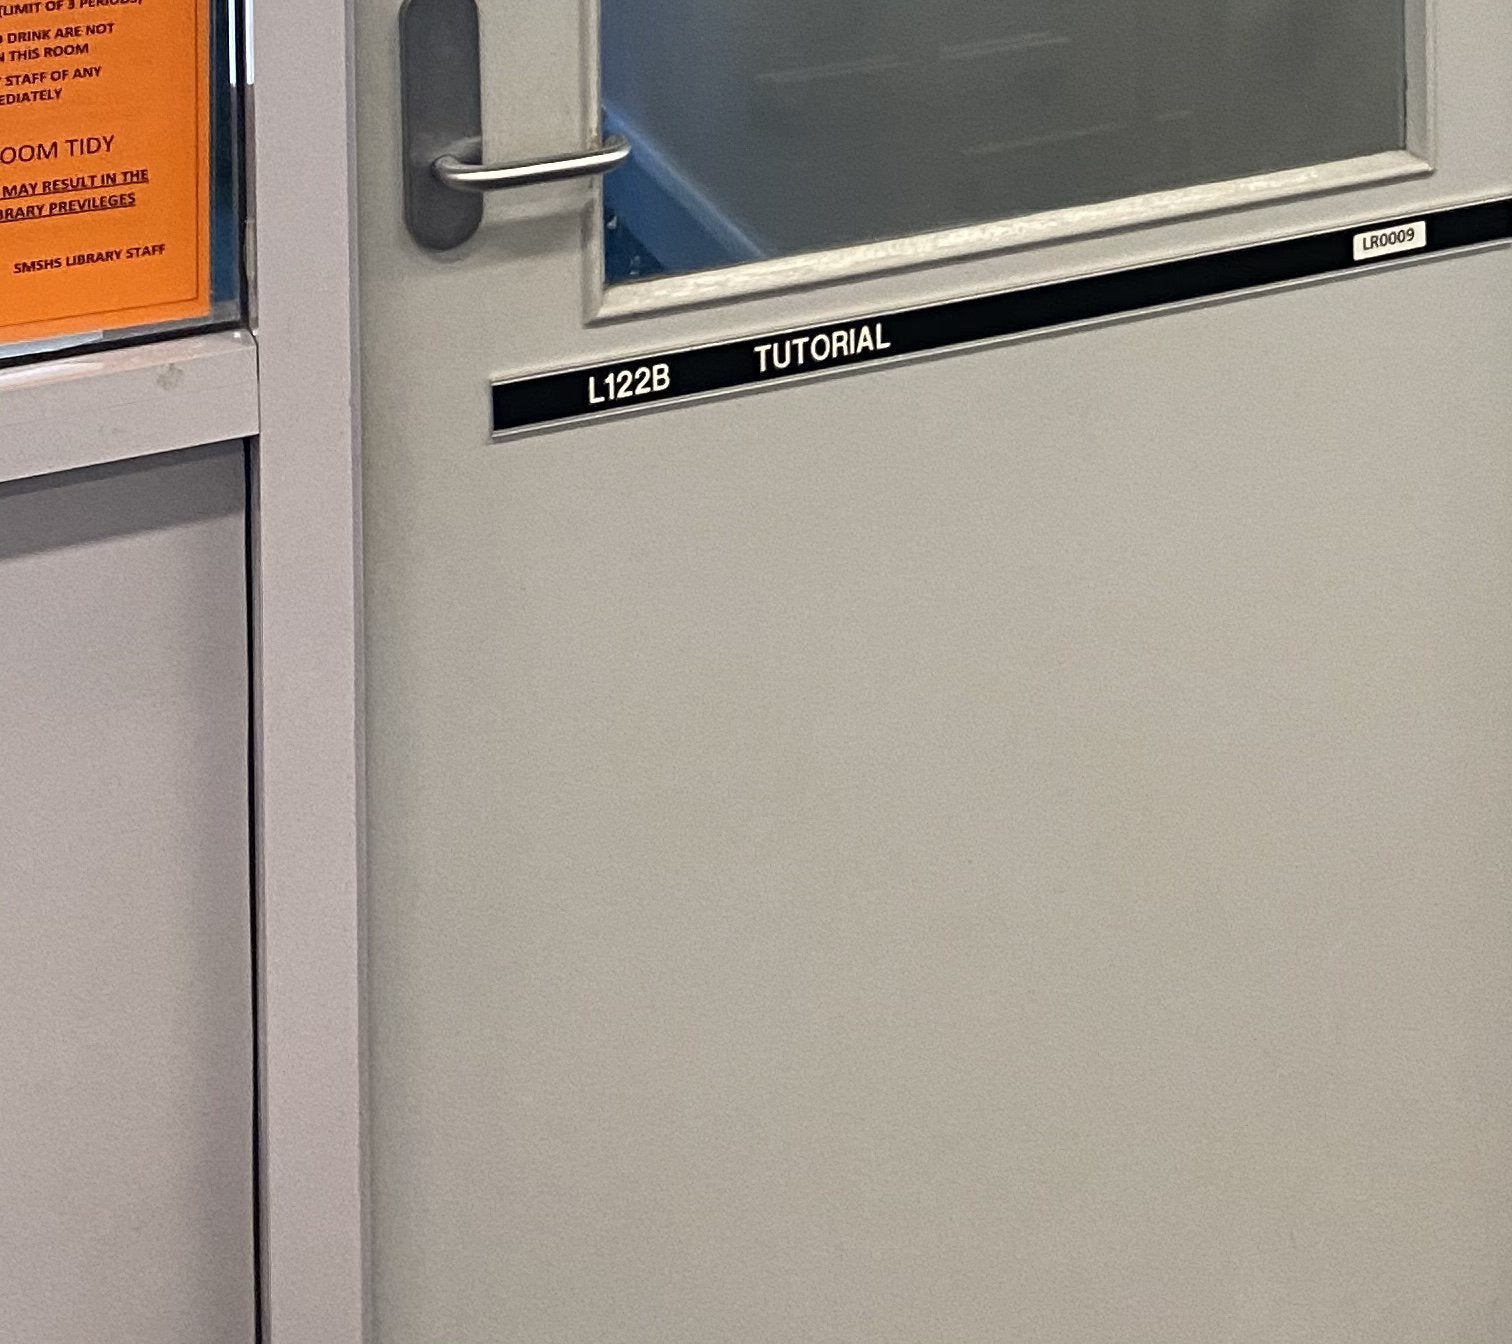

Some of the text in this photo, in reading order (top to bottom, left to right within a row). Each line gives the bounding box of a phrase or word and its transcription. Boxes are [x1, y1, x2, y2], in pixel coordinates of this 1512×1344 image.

[45, 0, 64, 12] OF
[67, 0, 75, 10] 3
[7, 29, 51, 43] DRINK
[54, 25, 81, 39] ARE
[86, 22, 115, 35] NOT
[9, 47, 40, 62] THIS
[44, 43, 89, 58] ROOM
[5, 72, 46, 86] STAFF
[50, 69, 69, 81] OF
[72, 66, 102, 80] ANY
[0, 88, 62, 106] EDIATELY
[0, 134, 115, 165] OOM TIDY
[2, 169, 149, 199] MAY RESULT IN THE
[49, 192, 136, 214] PREVILEGES
[1362, 227, 1415, 251] LR0009
[13, 243, 166, 274] SMSHS LIBRARY STAFF
[588, 322, 892, 405] L122B TUTORIAL
